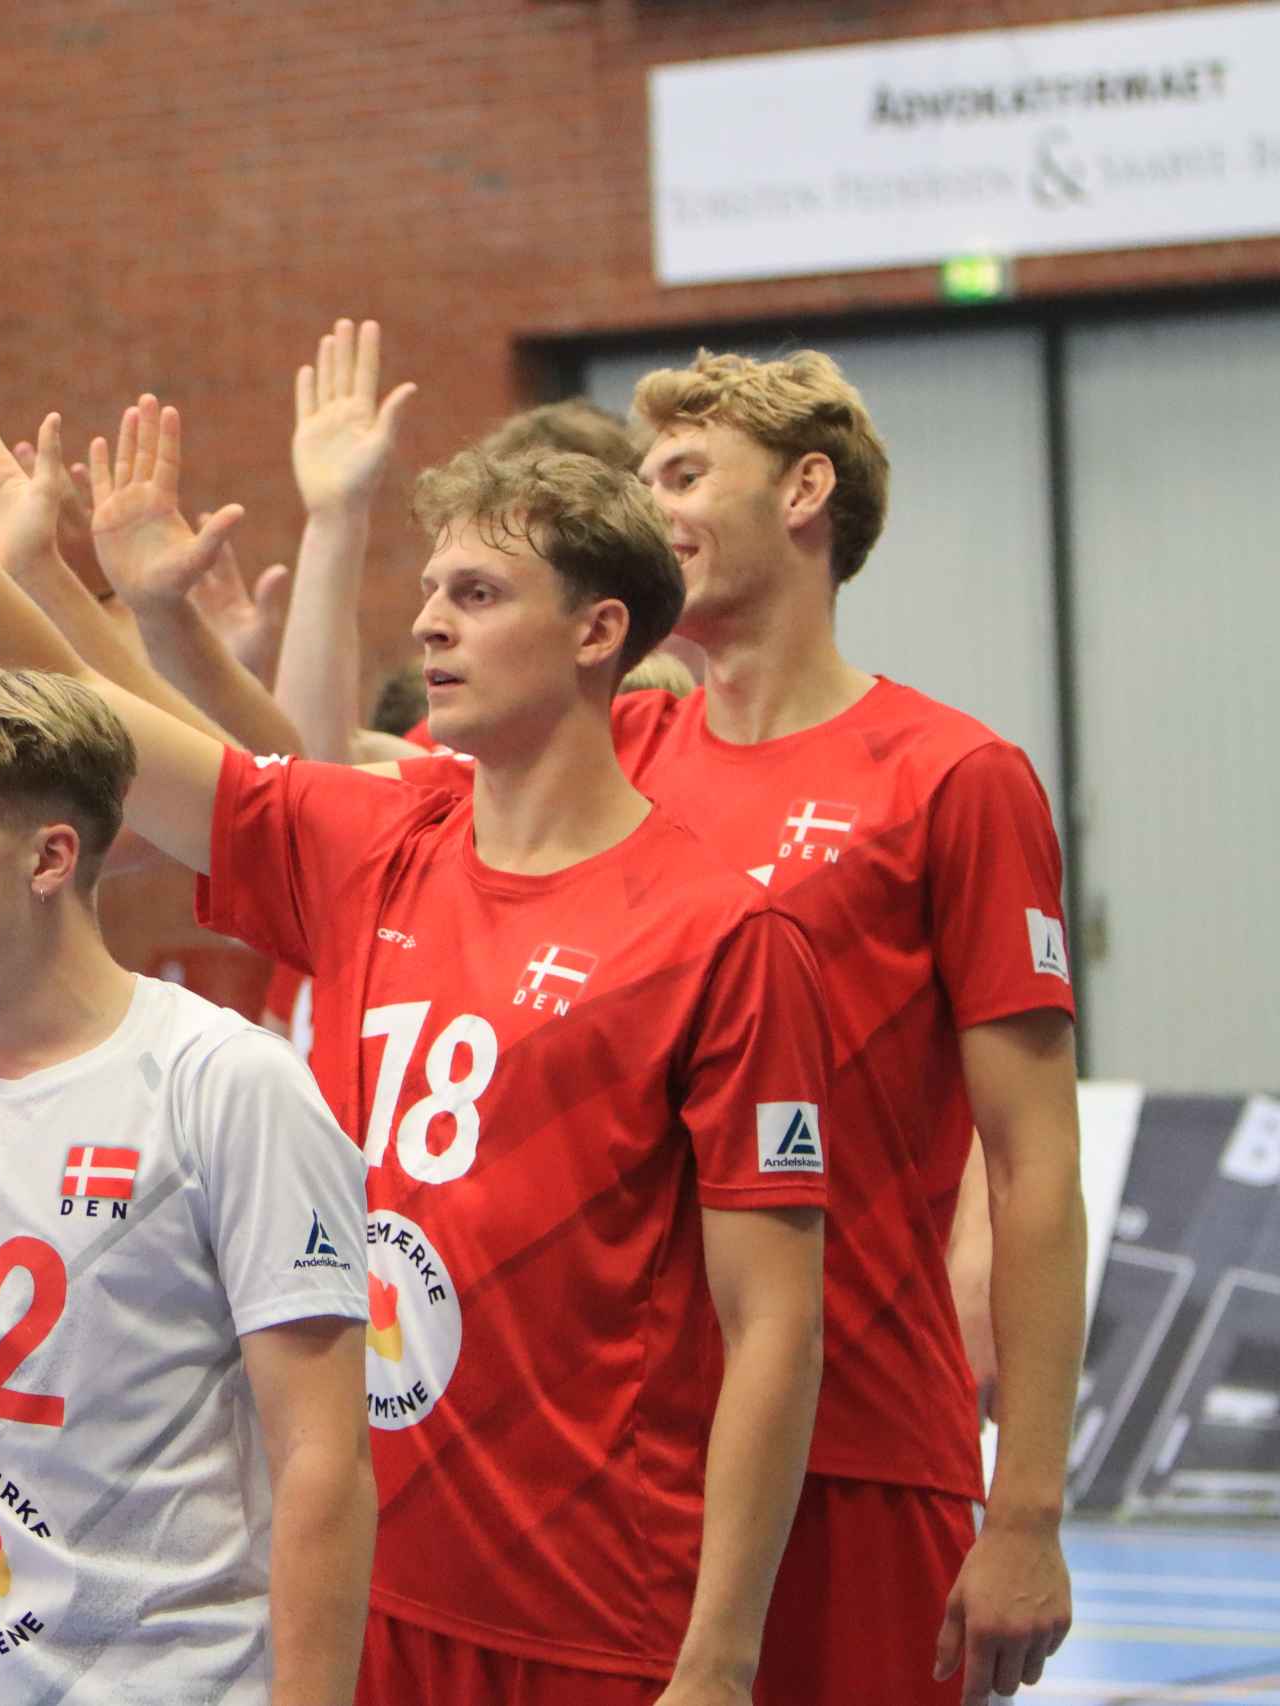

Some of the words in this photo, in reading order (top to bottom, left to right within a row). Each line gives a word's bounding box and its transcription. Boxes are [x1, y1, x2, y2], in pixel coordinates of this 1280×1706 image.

[1029, 125, 1089, 211] &
[778, 842, 840, 864] DEN
[512, 989, 571, 1017] DEN
[361, 1000, 498, 1184] 18
[60, 1198, 128, 1220] DEN
[367, 1222, 447, 1305] EMÆRKE
